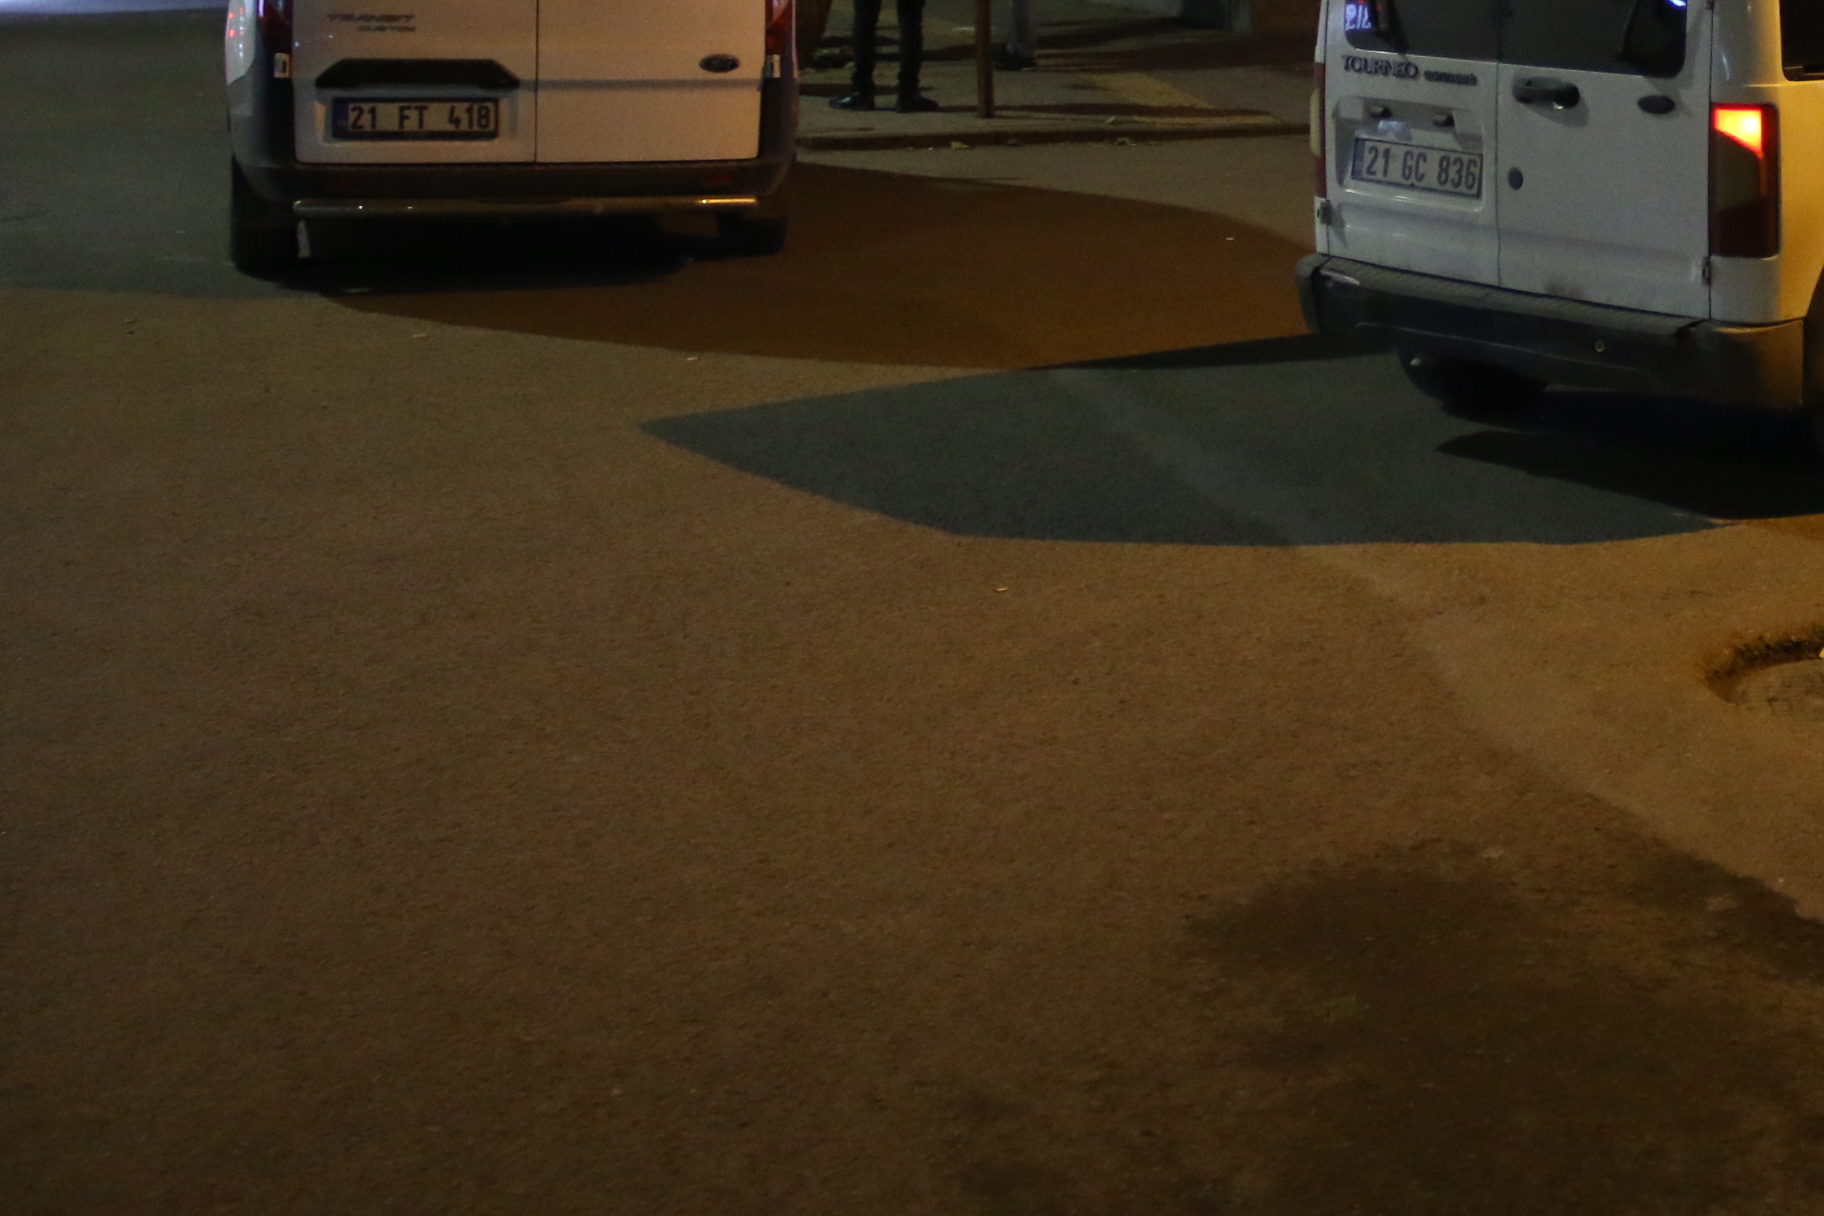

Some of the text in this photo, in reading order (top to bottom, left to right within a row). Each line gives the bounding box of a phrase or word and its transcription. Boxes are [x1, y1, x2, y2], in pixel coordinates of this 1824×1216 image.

[350, 105, 491, 130] 21 FT 418
[1365, 145, 1478, 190] 21 GC 836
